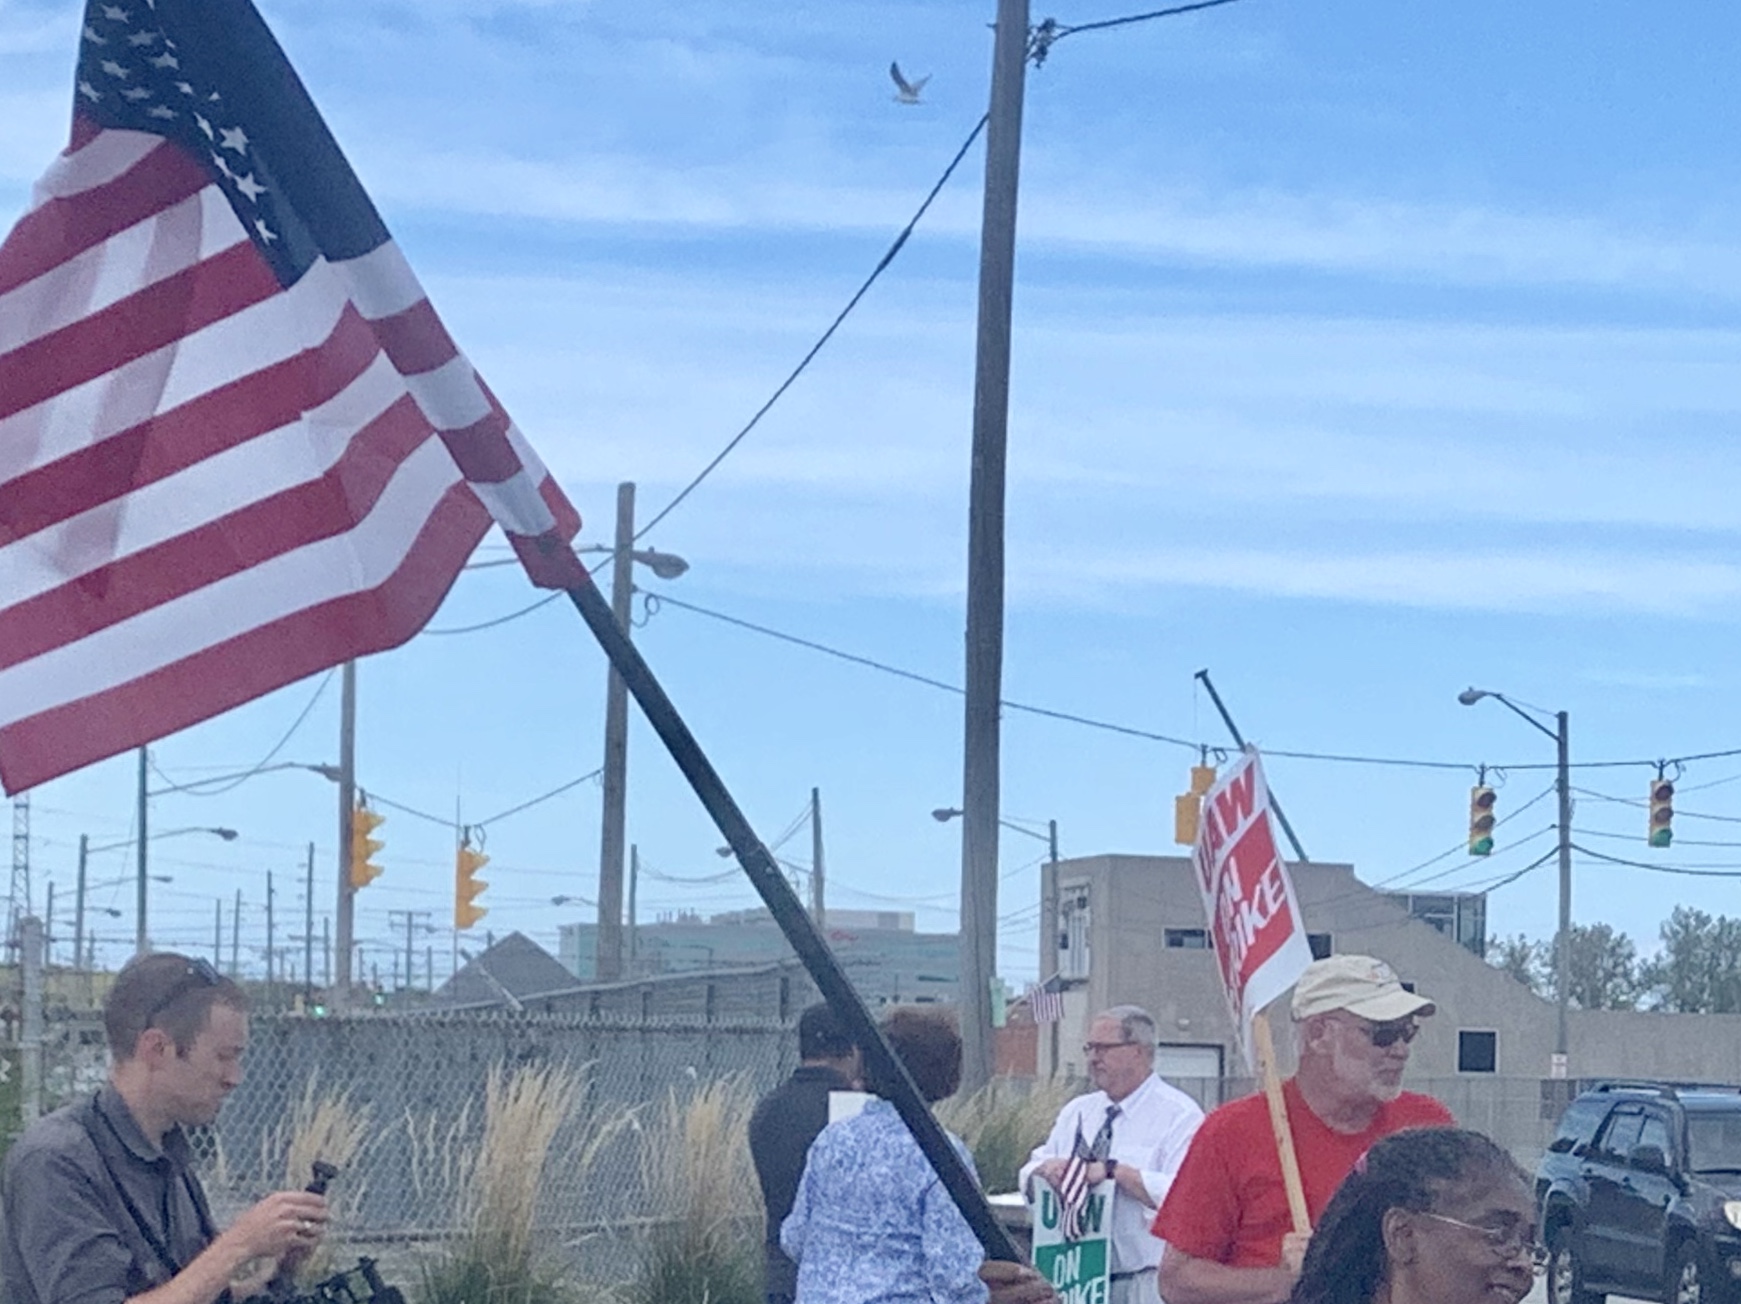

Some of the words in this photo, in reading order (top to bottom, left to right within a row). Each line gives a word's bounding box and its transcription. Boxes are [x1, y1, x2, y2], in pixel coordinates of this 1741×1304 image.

[1198, 759, 1256, 894] UAW
[1041, 1189, 1107, 1233] UW
[1052, 1245, 1082, 1289] ON
